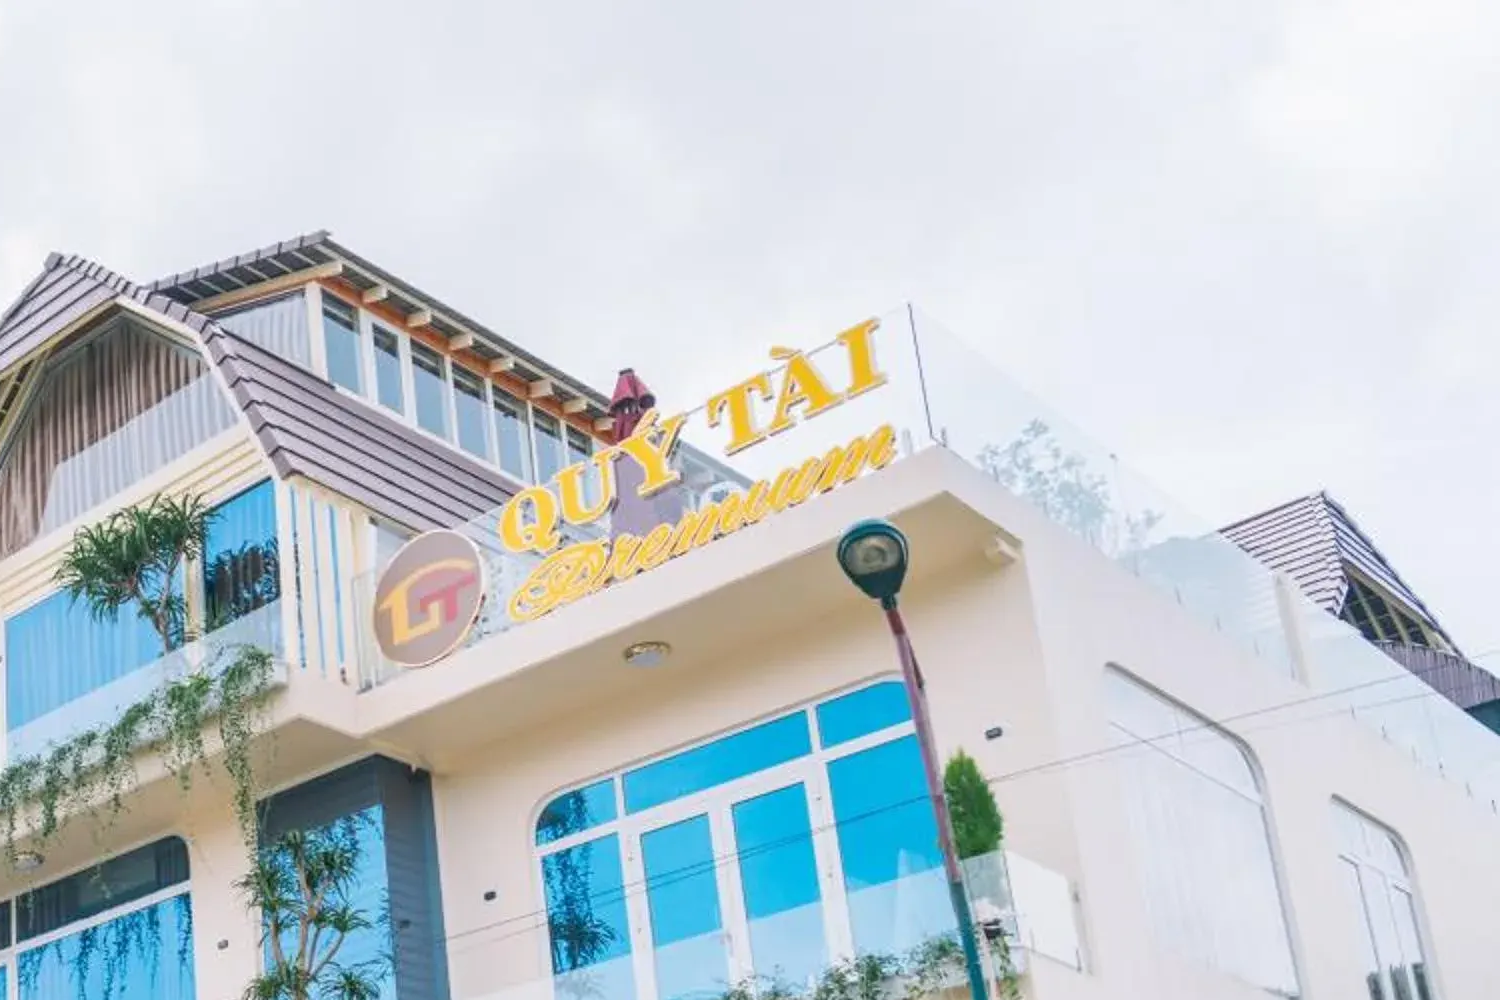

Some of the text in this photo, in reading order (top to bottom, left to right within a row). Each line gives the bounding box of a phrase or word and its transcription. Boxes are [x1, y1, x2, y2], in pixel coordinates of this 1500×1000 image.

[500, 317, 888, 554] QUÝ TÀI
[508, 423, 898, 622] Premium
